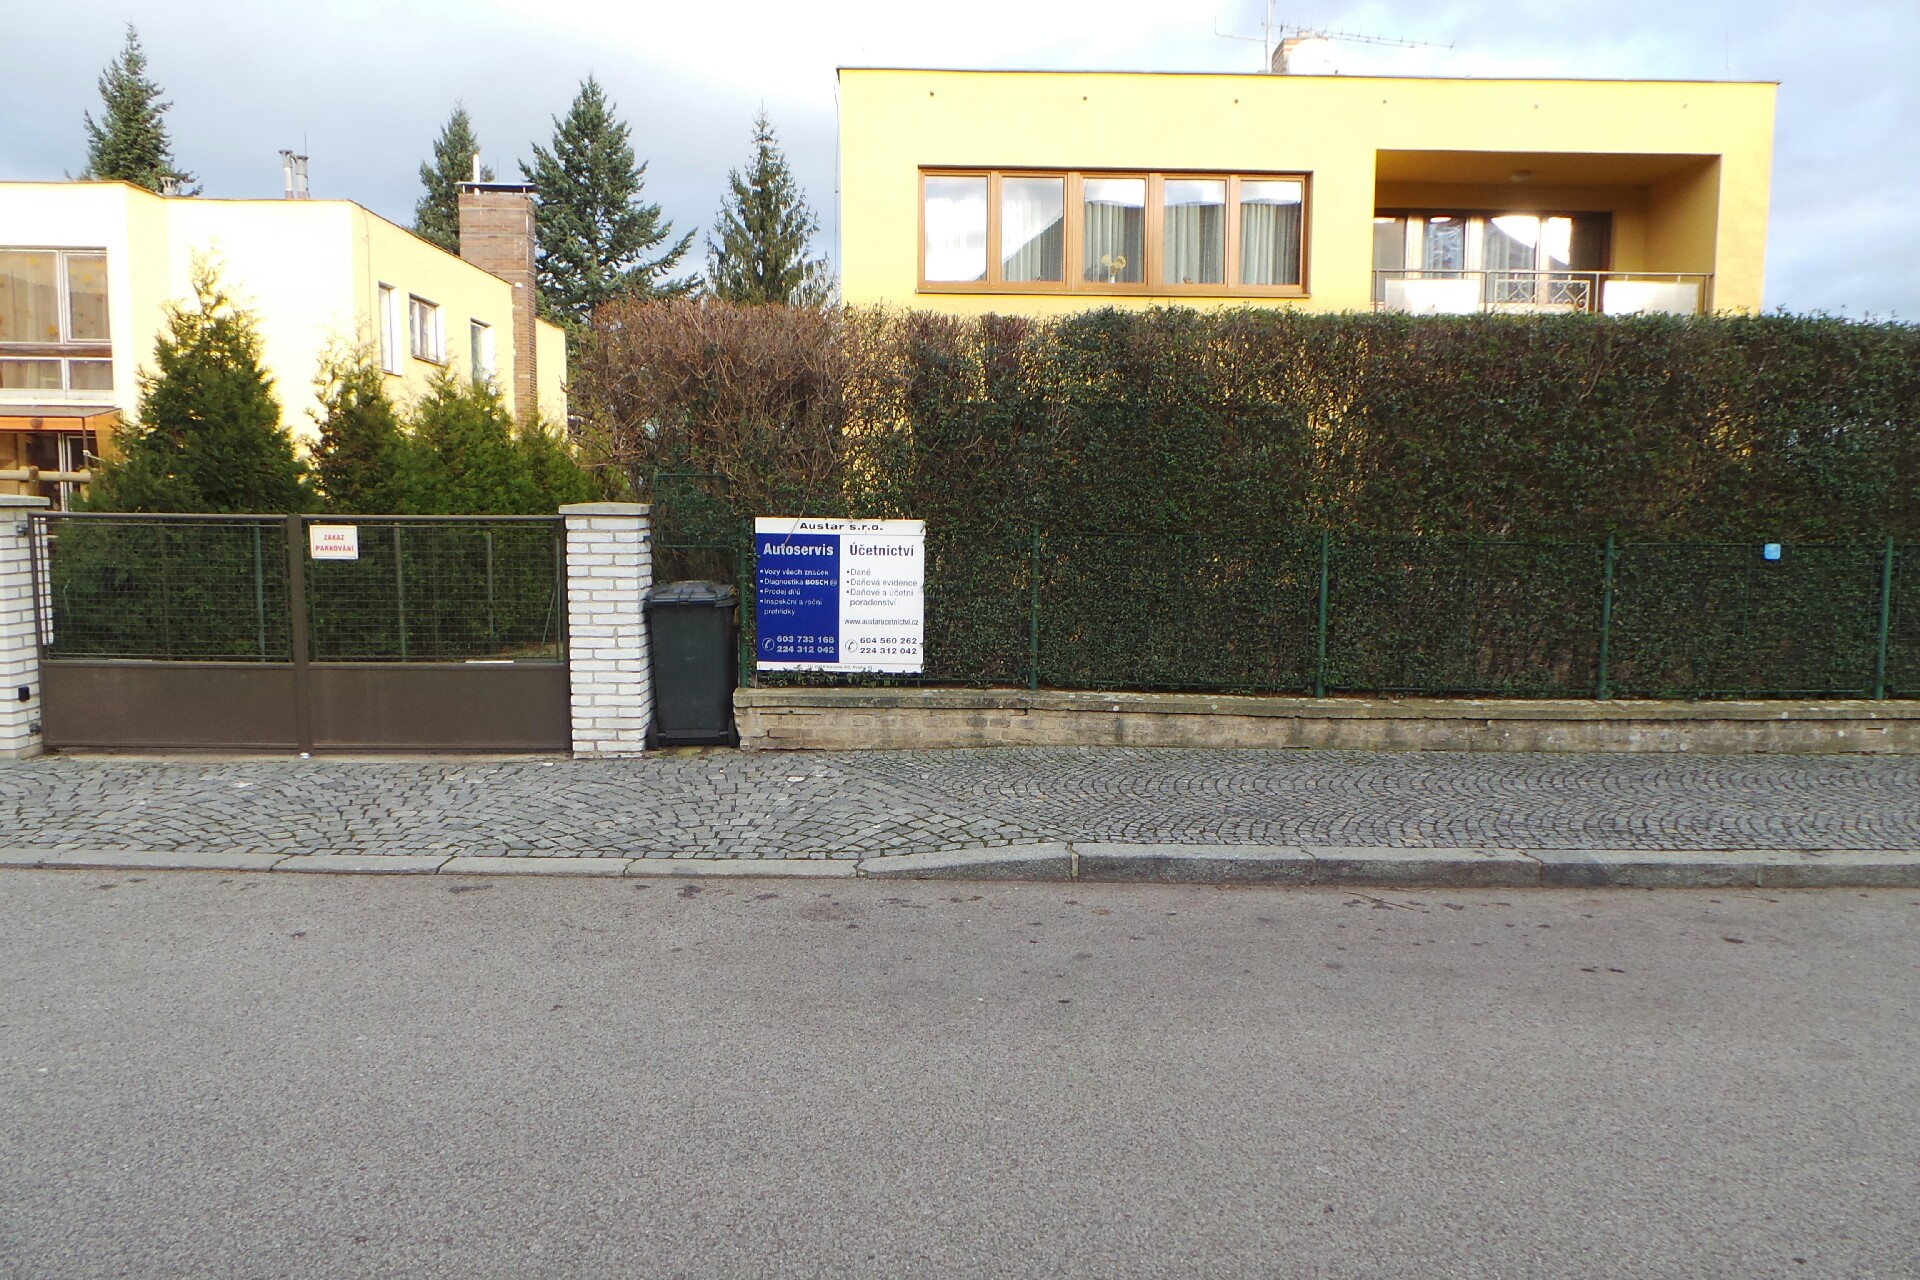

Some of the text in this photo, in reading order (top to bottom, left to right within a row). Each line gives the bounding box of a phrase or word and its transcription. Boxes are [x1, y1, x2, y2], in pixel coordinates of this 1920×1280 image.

[800, 522, 883, 531] Austar s.r.o.
[763, 542, 834, 556] Autoservis
[849, 541, 914, 557] Účetnictví
[763, 567, 781, 577] Vozy
[782, 568, 803, 576] všech
[850, 568, 871, 576] Daně
[764, 577, 804, 587] Diagnostika
[850, 578, 918, 587] Daňová evidence
[764, 588, 787, 596] Prodej
[776, 635, 794, 643] 603
[817, 636, 835, 644] 168
[880, 637, 897, 645] 560
[900, 637, 918, 645] 262
[776, 645, 835, 654] 224 312 042
[880, 647, 897, 655] 312
[900, 647, 918, 655] 042
